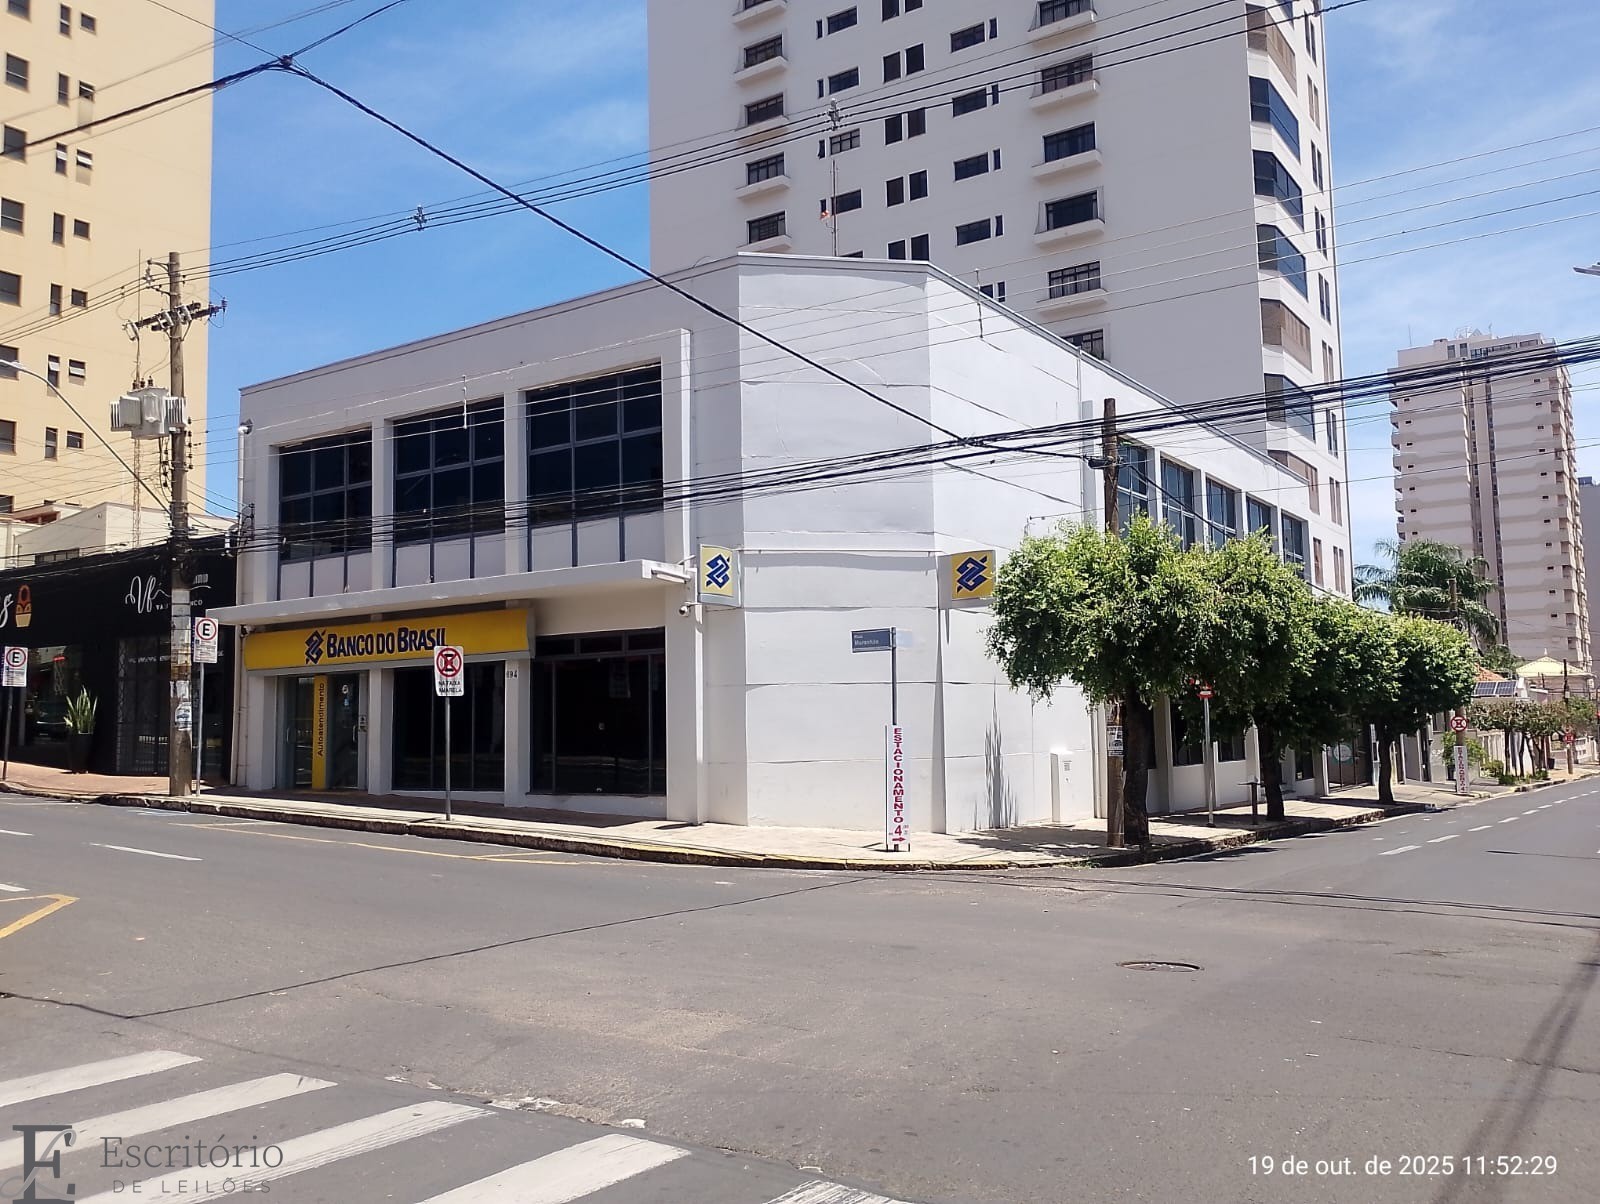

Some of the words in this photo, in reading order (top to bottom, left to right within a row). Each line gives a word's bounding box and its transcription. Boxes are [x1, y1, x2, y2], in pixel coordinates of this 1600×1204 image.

[202, 623, 211, 636] E
[327, 633, 373, 658] BANCO
[376, 632, 395, 654] DO
[397, 627, 448, 652] BRASIL
[12, 652, 20, 663] E
[317, 682, 325, 757] Autoatendimento
[893, 727, 905, 824] ESTACIONAMENTO
